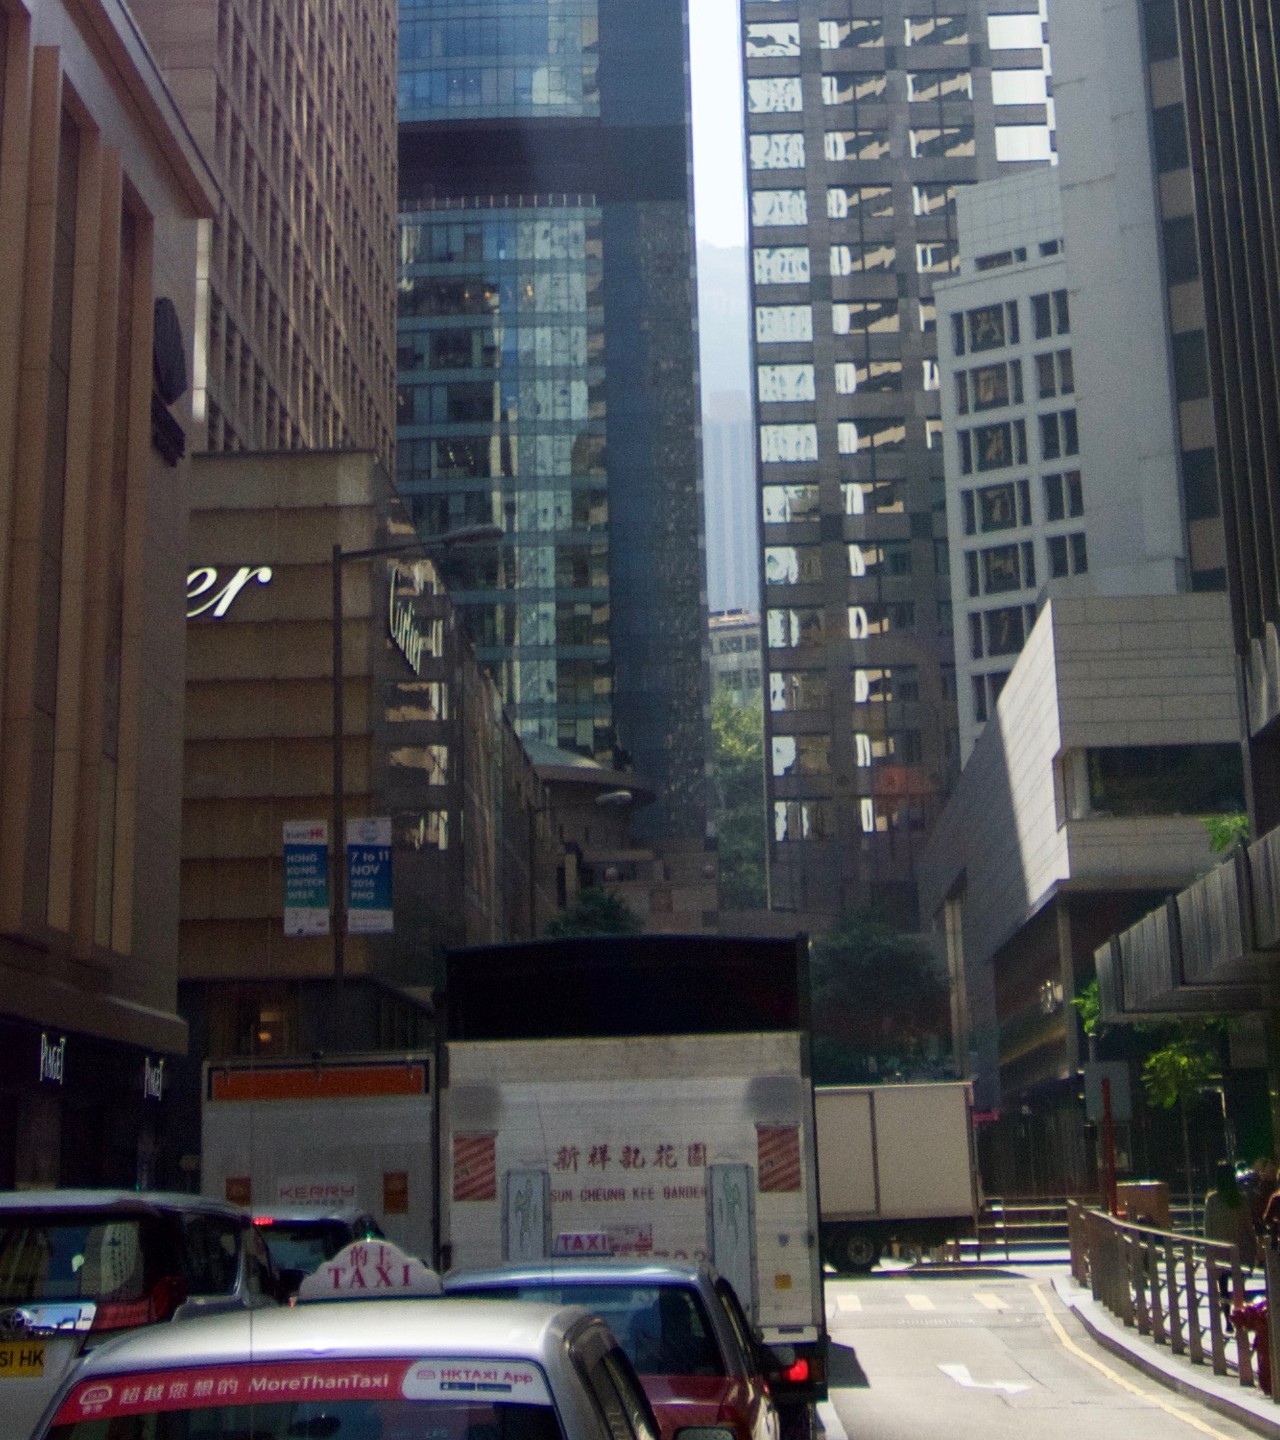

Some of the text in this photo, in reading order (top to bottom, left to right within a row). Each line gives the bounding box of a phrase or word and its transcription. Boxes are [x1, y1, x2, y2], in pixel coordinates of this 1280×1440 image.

[280, 1184, 355, 1199] KERRY
[561, 1234, 608, 1251] TAXI
[350, 1246, 392, 1267] 的士
[327, 1265, 410, 1289] TAXI
[19, 1351, 45, 1368] HK
[249, 1371, 389, 1392] MoreThanTaxi
[503, 1370, 533, 1385] App
